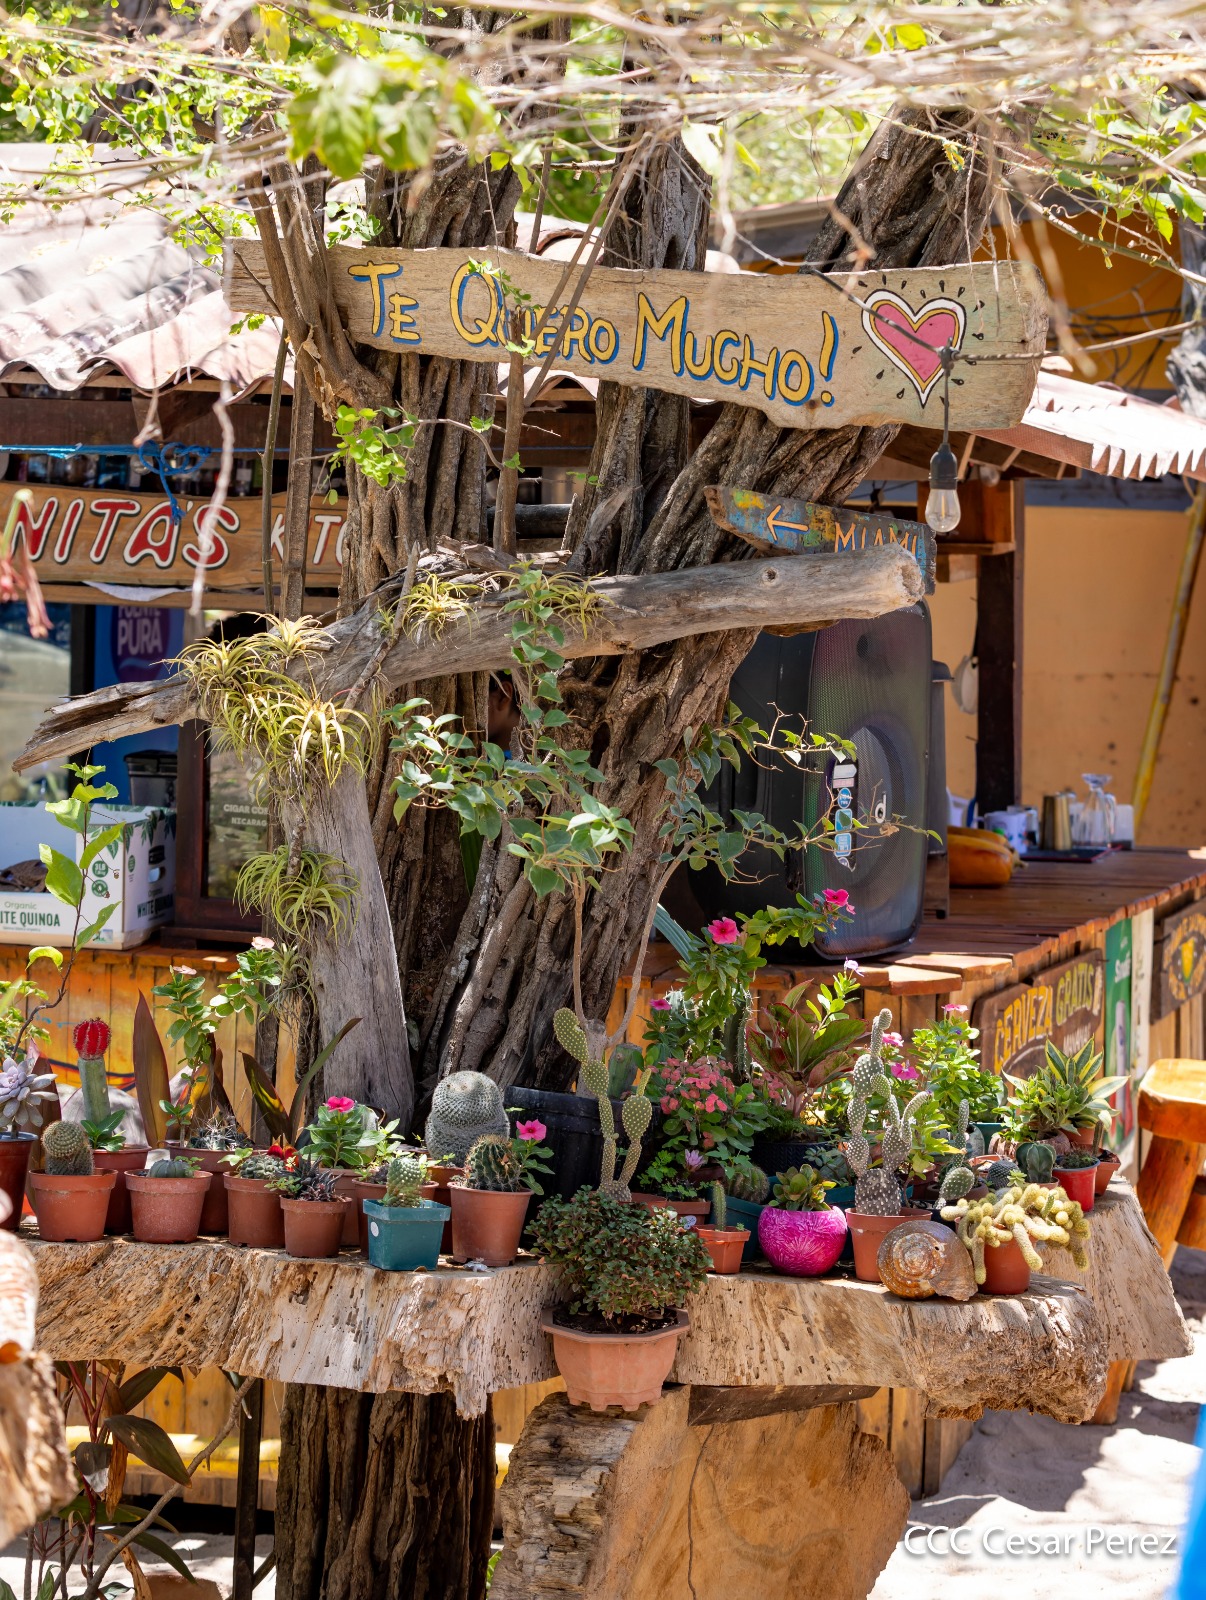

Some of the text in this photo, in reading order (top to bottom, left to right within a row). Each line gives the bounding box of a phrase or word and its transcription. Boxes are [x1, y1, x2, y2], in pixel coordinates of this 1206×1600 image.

[347, 261, 421, 345] TE
[632, 291, 836, 407] MUCHO!
[117, 618, 163, 656] PURA
[223, 804, 250, 814] CIGAR
[4, 901, 37, 910] Organic
[19, 911, 61, 927] QUINOA
[993, 962, 1095, 1075] CERVEZA GRATIS
